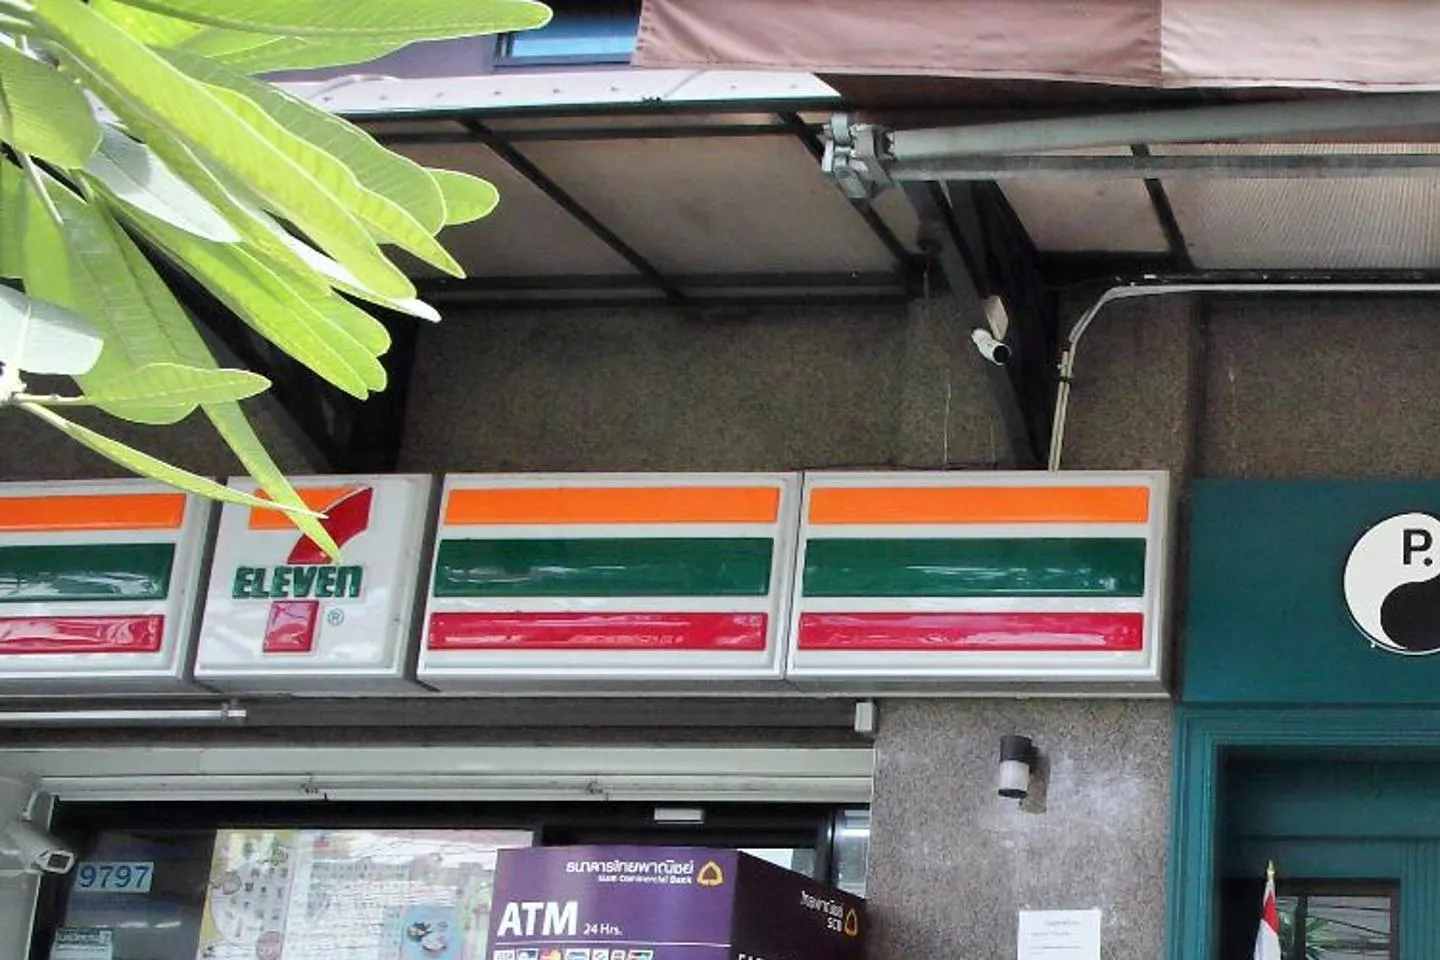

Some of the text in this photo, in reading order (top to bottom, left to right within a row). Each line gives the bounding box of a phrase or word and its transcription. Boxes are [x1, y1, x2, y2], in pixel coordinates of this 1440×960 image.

[231, 565, 363, 600] ELEVEN
[79, 866, 149, 889] 9797
[497, 901, 578, 937] ATM
[583, 923, 598, 936] 24
